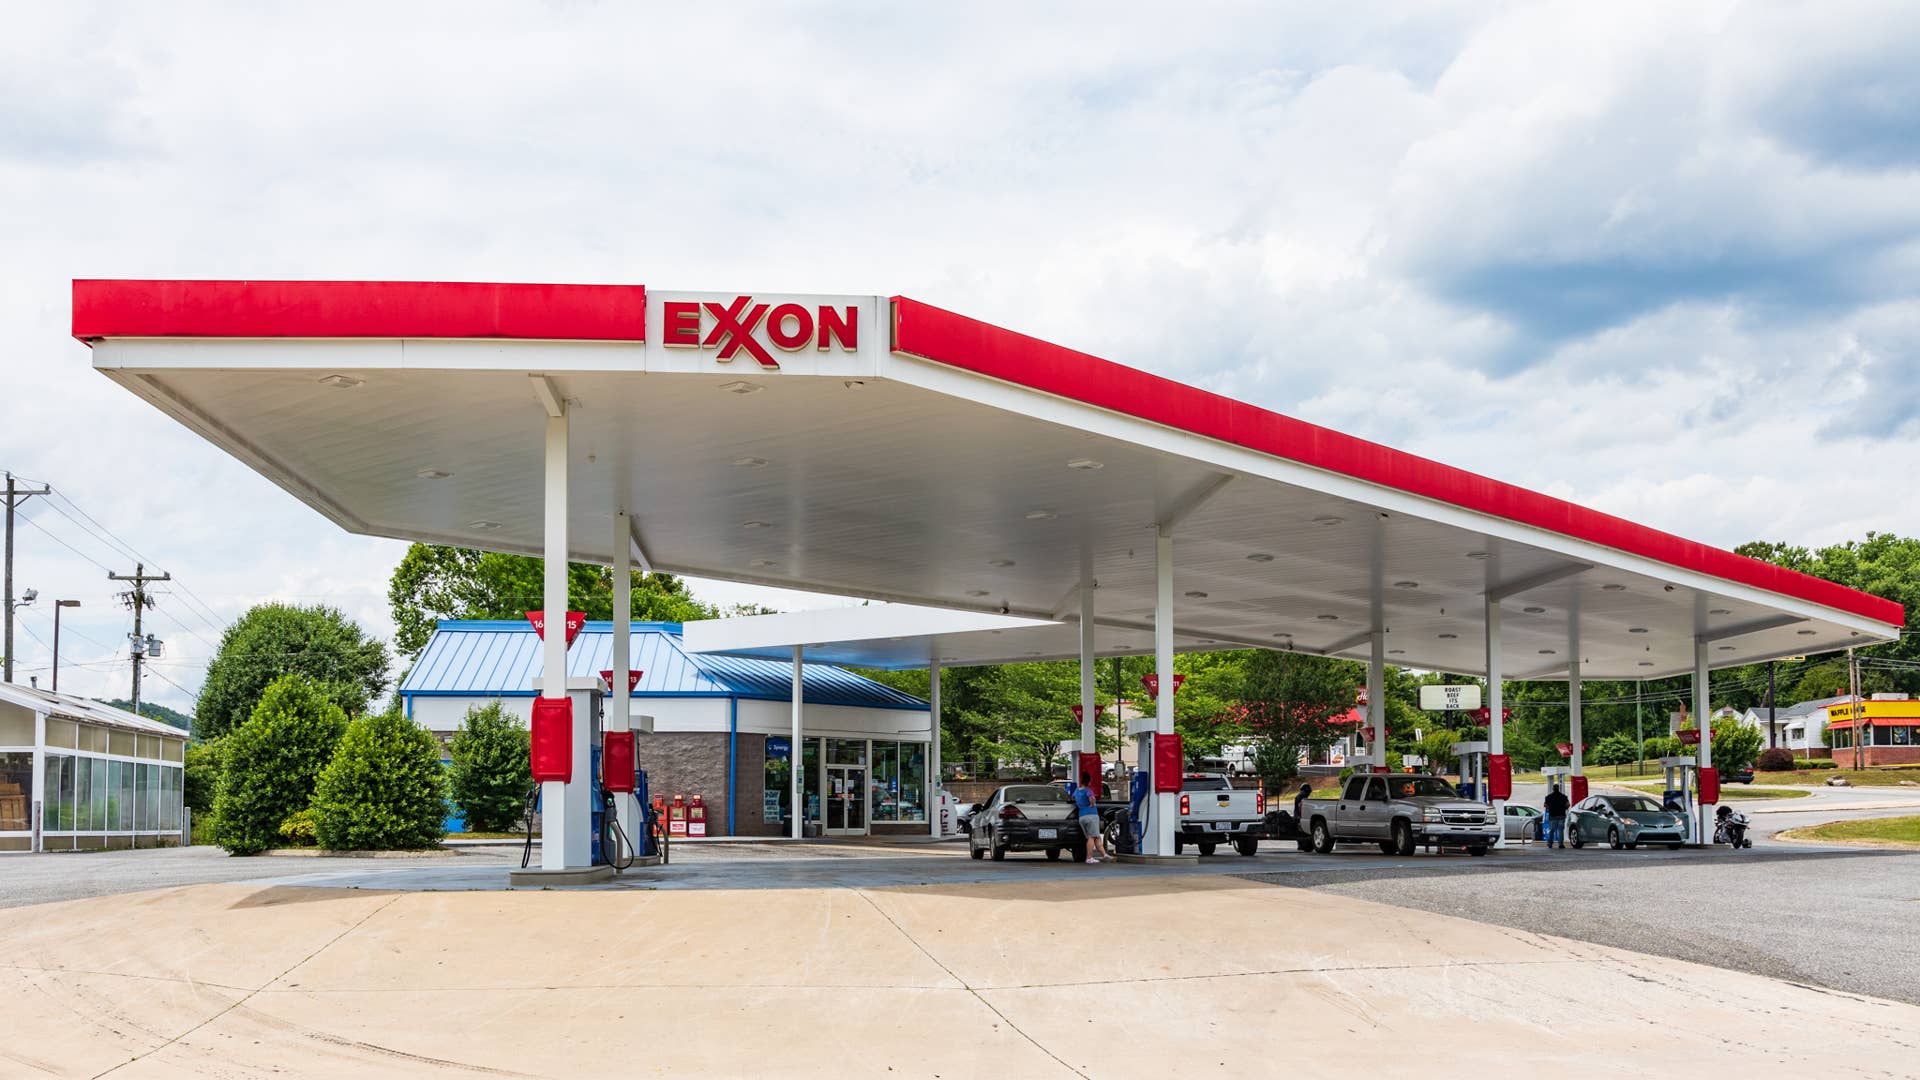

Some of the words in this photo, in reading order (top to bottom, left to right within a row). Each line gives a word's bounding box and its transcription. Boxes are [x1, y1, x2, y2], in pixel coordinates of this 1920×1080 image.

[663, 296, 859, 369] EXXON
[534, 620, 544, 629] 16
[567, 620, 577, 629] 15
